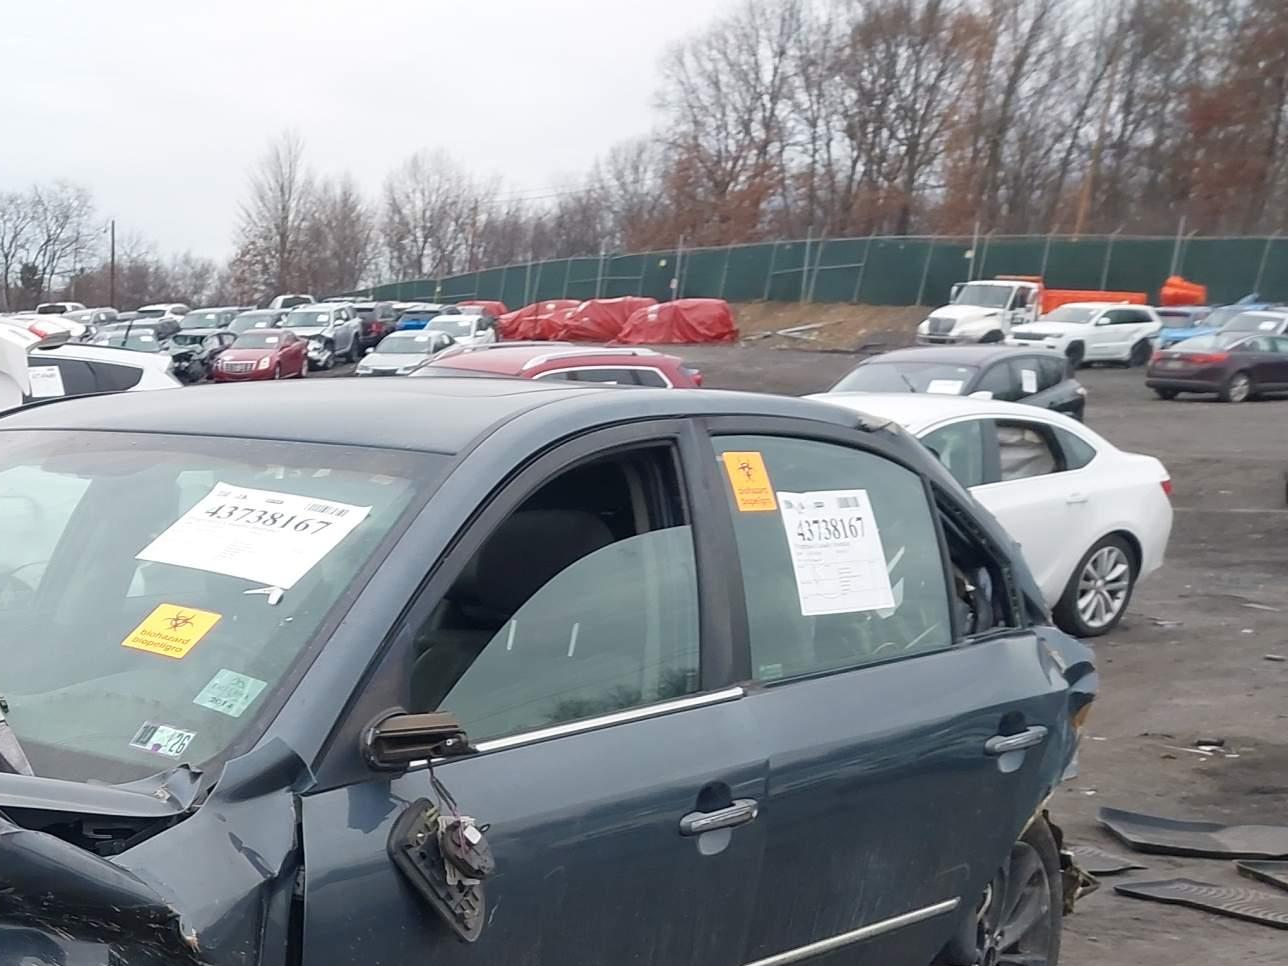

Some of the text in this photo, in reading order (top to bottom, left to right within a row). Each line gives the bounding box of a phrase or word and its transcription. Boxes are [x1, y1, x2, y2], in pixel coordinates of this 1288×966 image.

[205, 504, 333, 535] 43738167
[797, 516, 867, 542] 43738167
[131, 636, 183, 653] biopeligro
[139, 628, 191, 645] biohazard
[168, 733, 191, 754] 26
